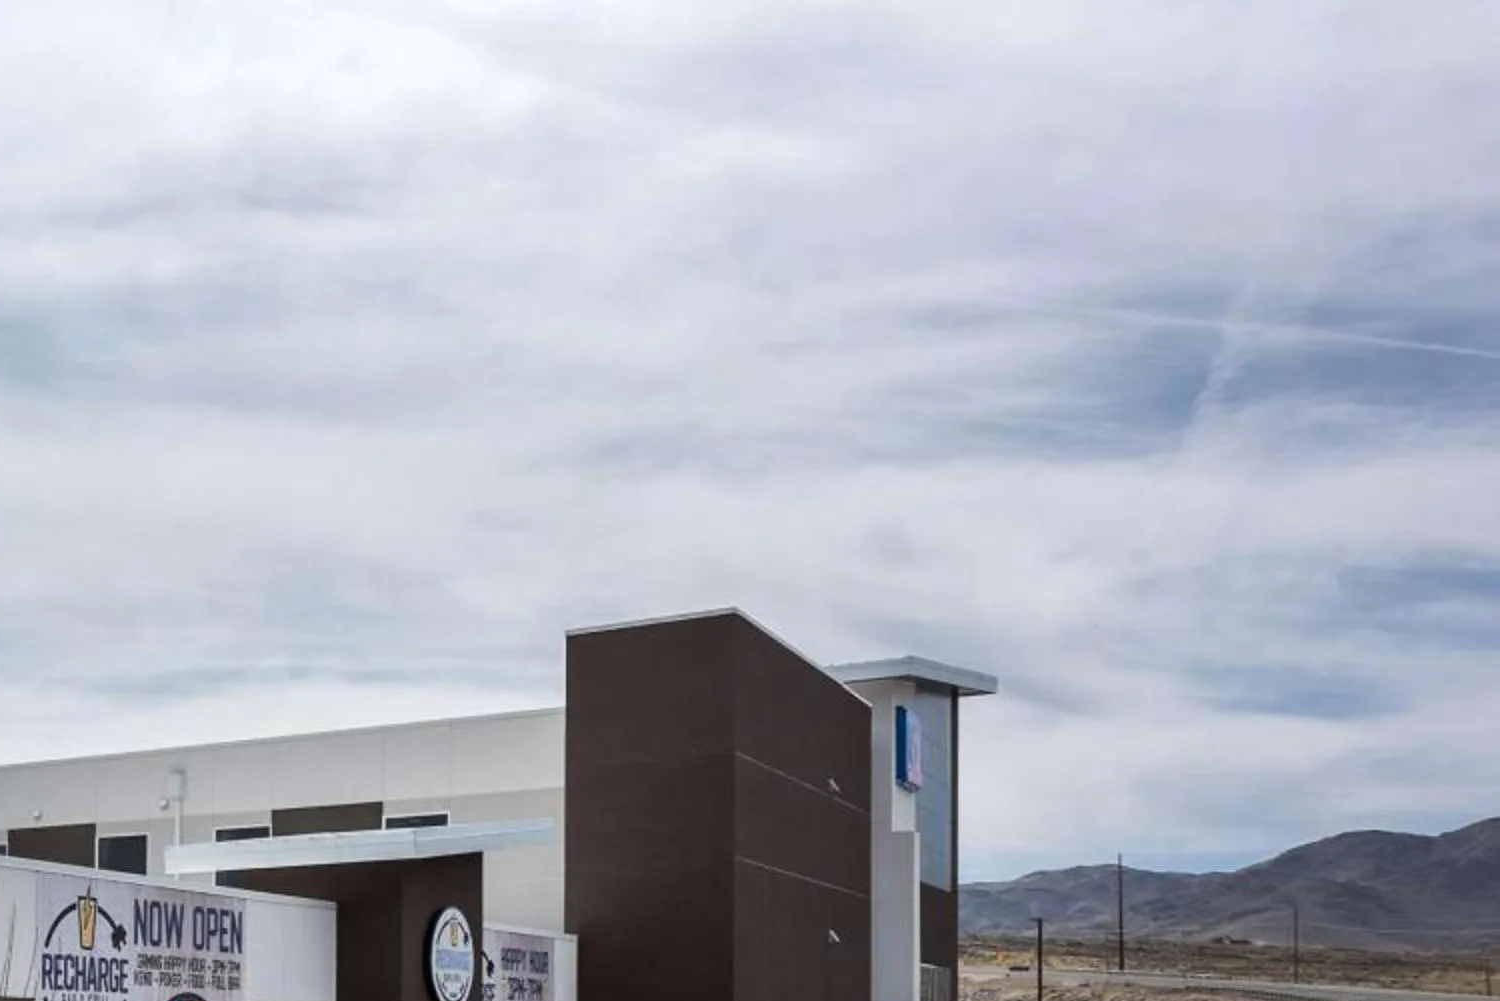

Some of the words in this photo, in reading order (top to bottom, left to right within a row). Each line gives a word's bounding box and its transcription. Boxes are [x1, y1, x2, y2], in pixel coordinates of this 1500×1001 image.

[134, 898, 184, 949] NOW
[193, 906, 242, 954] OPEN
[42, 953, 129, 994] RECHARGE
